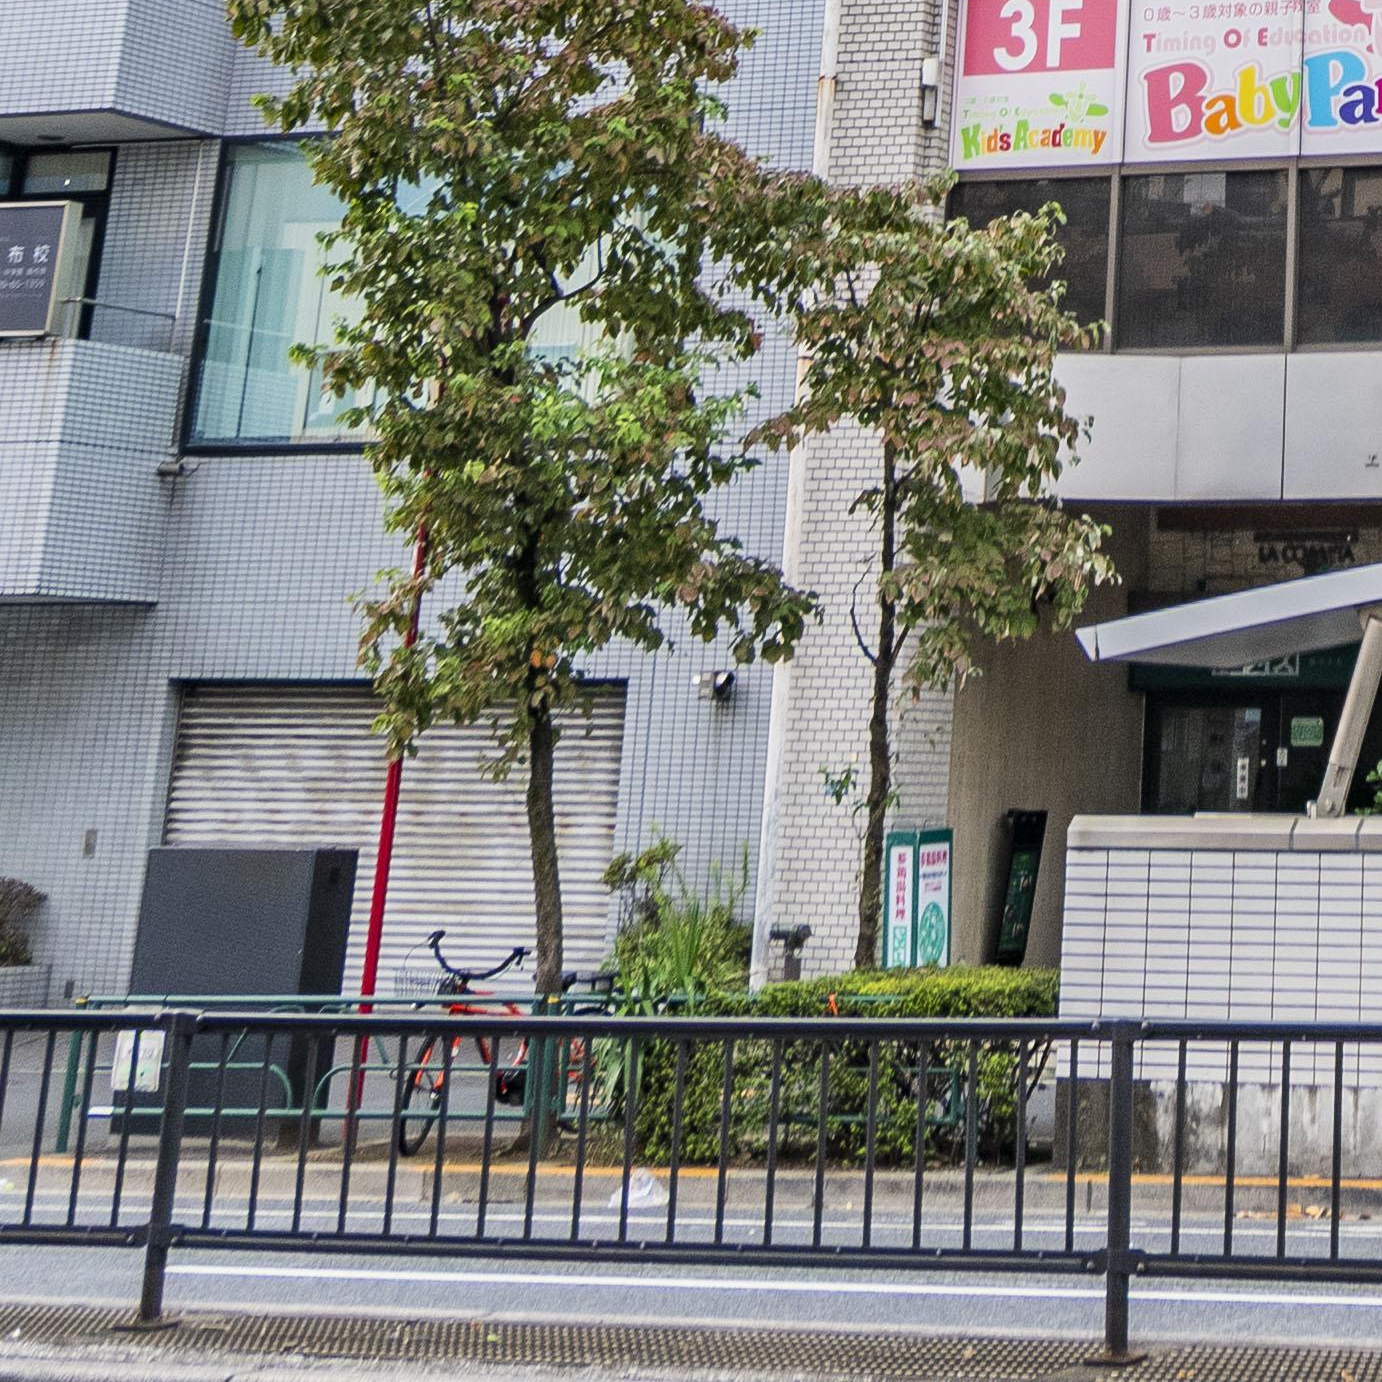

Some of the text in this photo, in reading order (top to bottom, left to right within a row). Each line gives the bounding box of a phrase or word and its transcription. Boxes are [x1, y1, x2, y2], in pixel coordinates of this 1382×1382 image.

[1143, 22, 1366, 55] Timing Of Education
